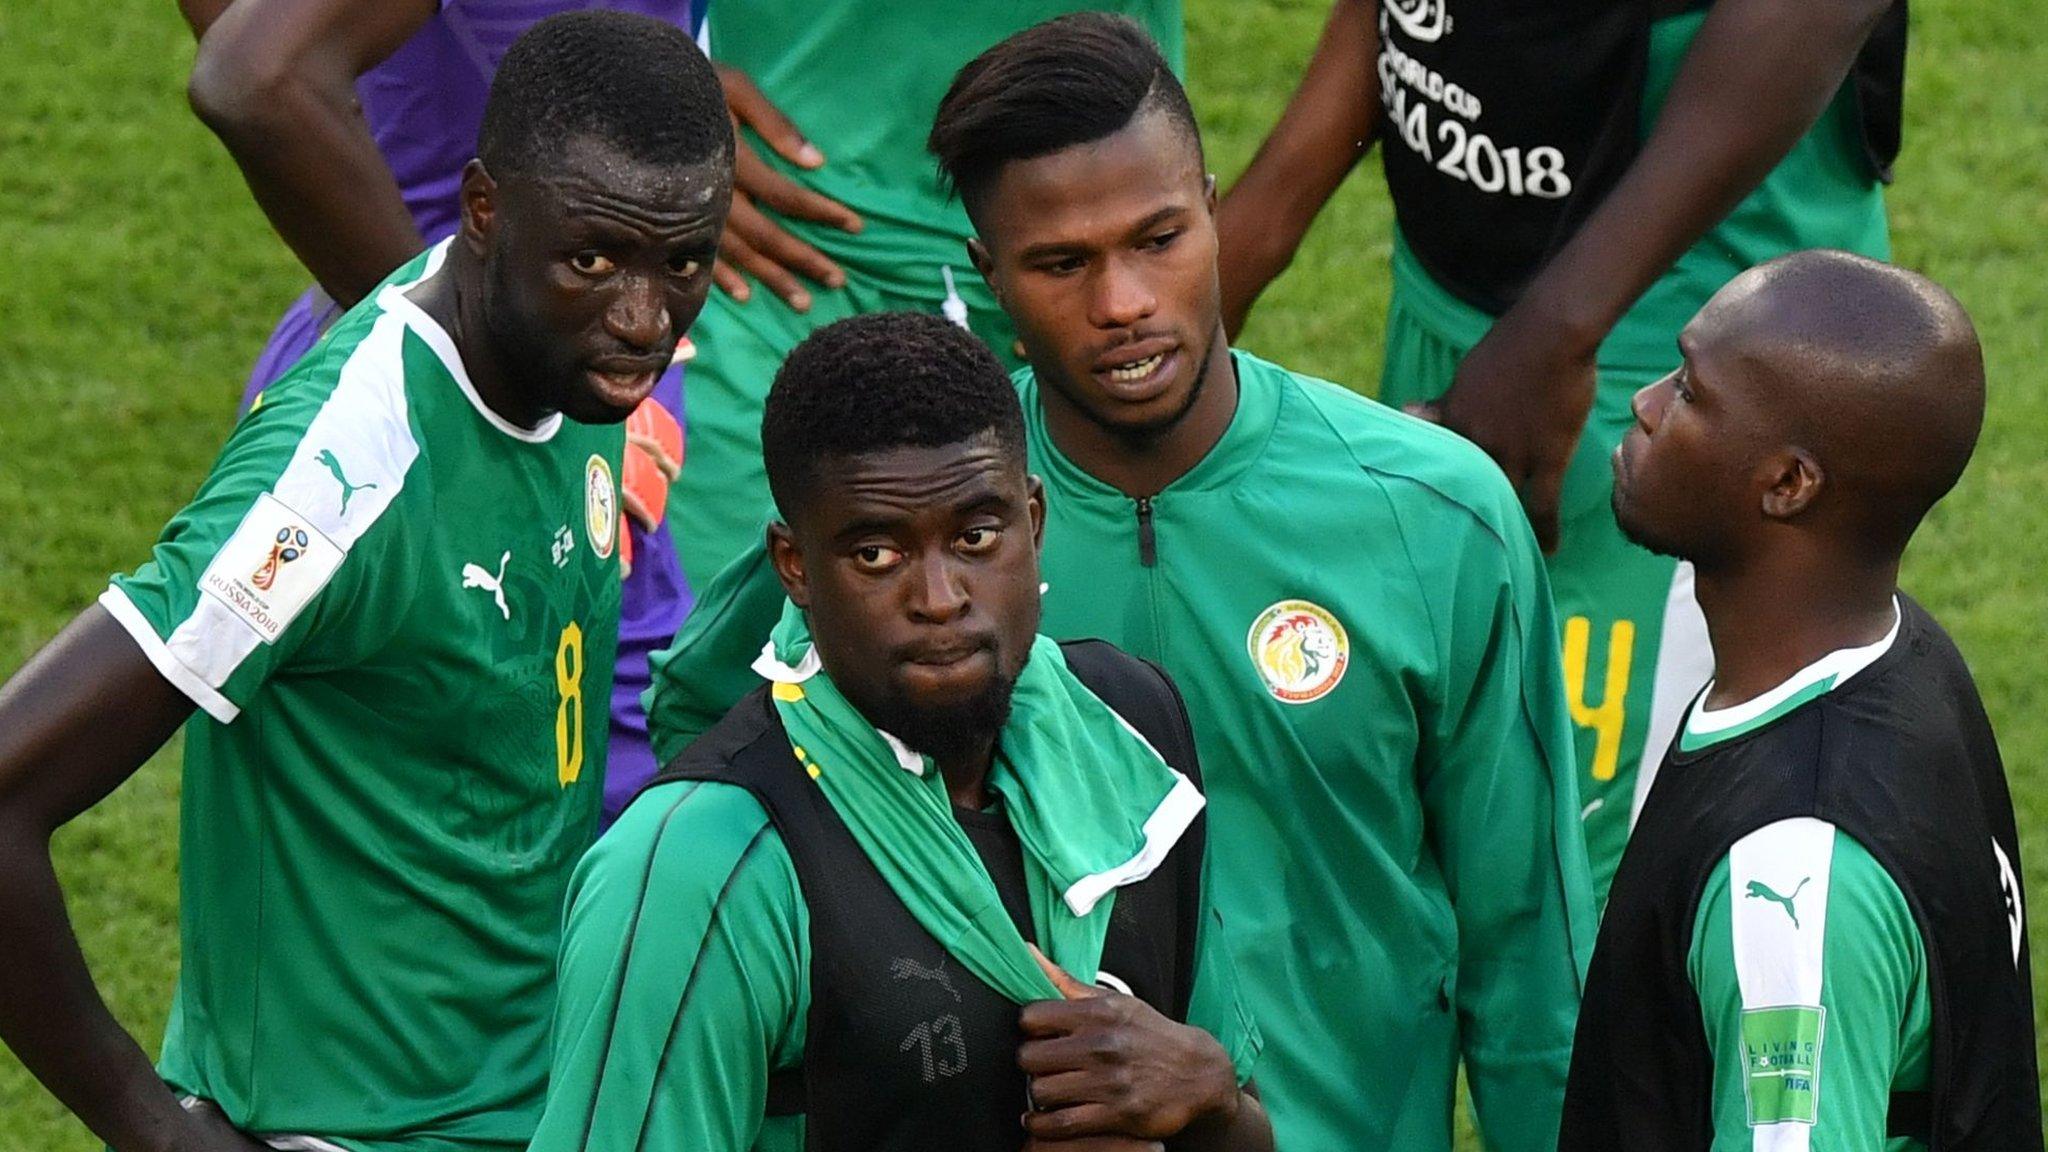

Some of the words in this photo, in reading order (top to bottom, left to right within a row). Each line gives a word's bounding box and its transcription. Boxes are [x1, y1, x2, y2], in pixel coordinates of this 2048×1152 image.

[1443, 83, 1482, 122] CUP
[1436, 119, 1572, 198] 2018
[209, 574, 250, 612] RUSSIA
[249, 606, 280, 634] 2018
[556, 620, 584, 789] 8
[1562, 616, 1636, 781] 4
[900, 1014, 968, 1085] 13
[1748, 1041, 1813, 1055] LIVING
